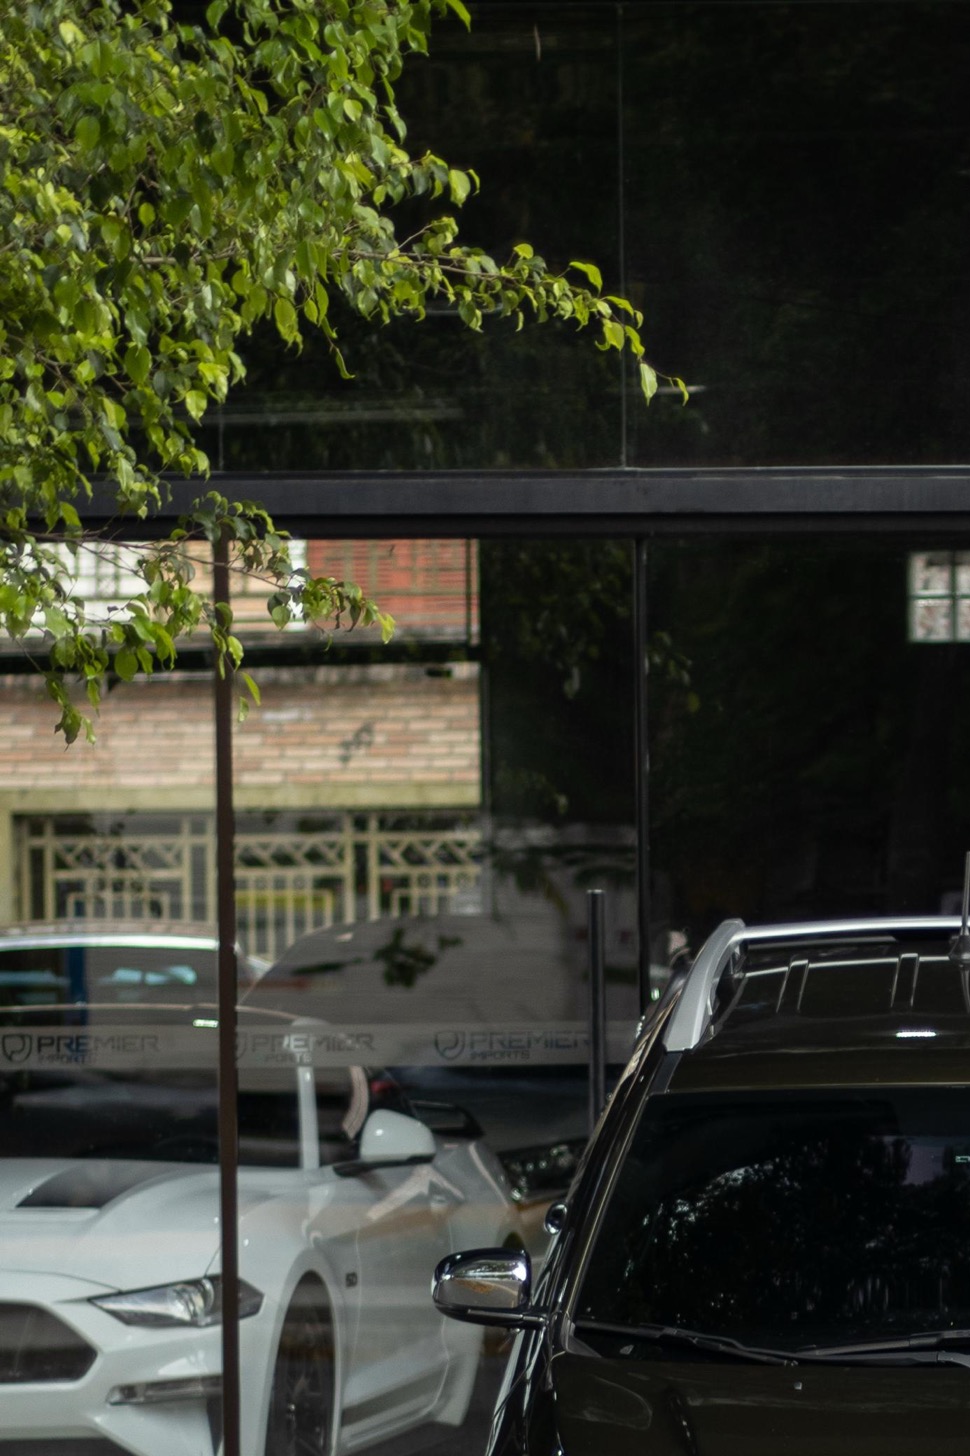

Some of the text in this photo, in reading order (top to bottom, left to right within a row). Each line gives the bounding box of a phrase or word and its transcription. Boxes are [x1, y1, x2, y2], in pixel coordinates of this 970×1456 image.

[37, 1035, 159, 1053] PREMIER
[252, 1033, 375, 1052] PREMIER
[469, 1031, 592, 1050] PREMIER
